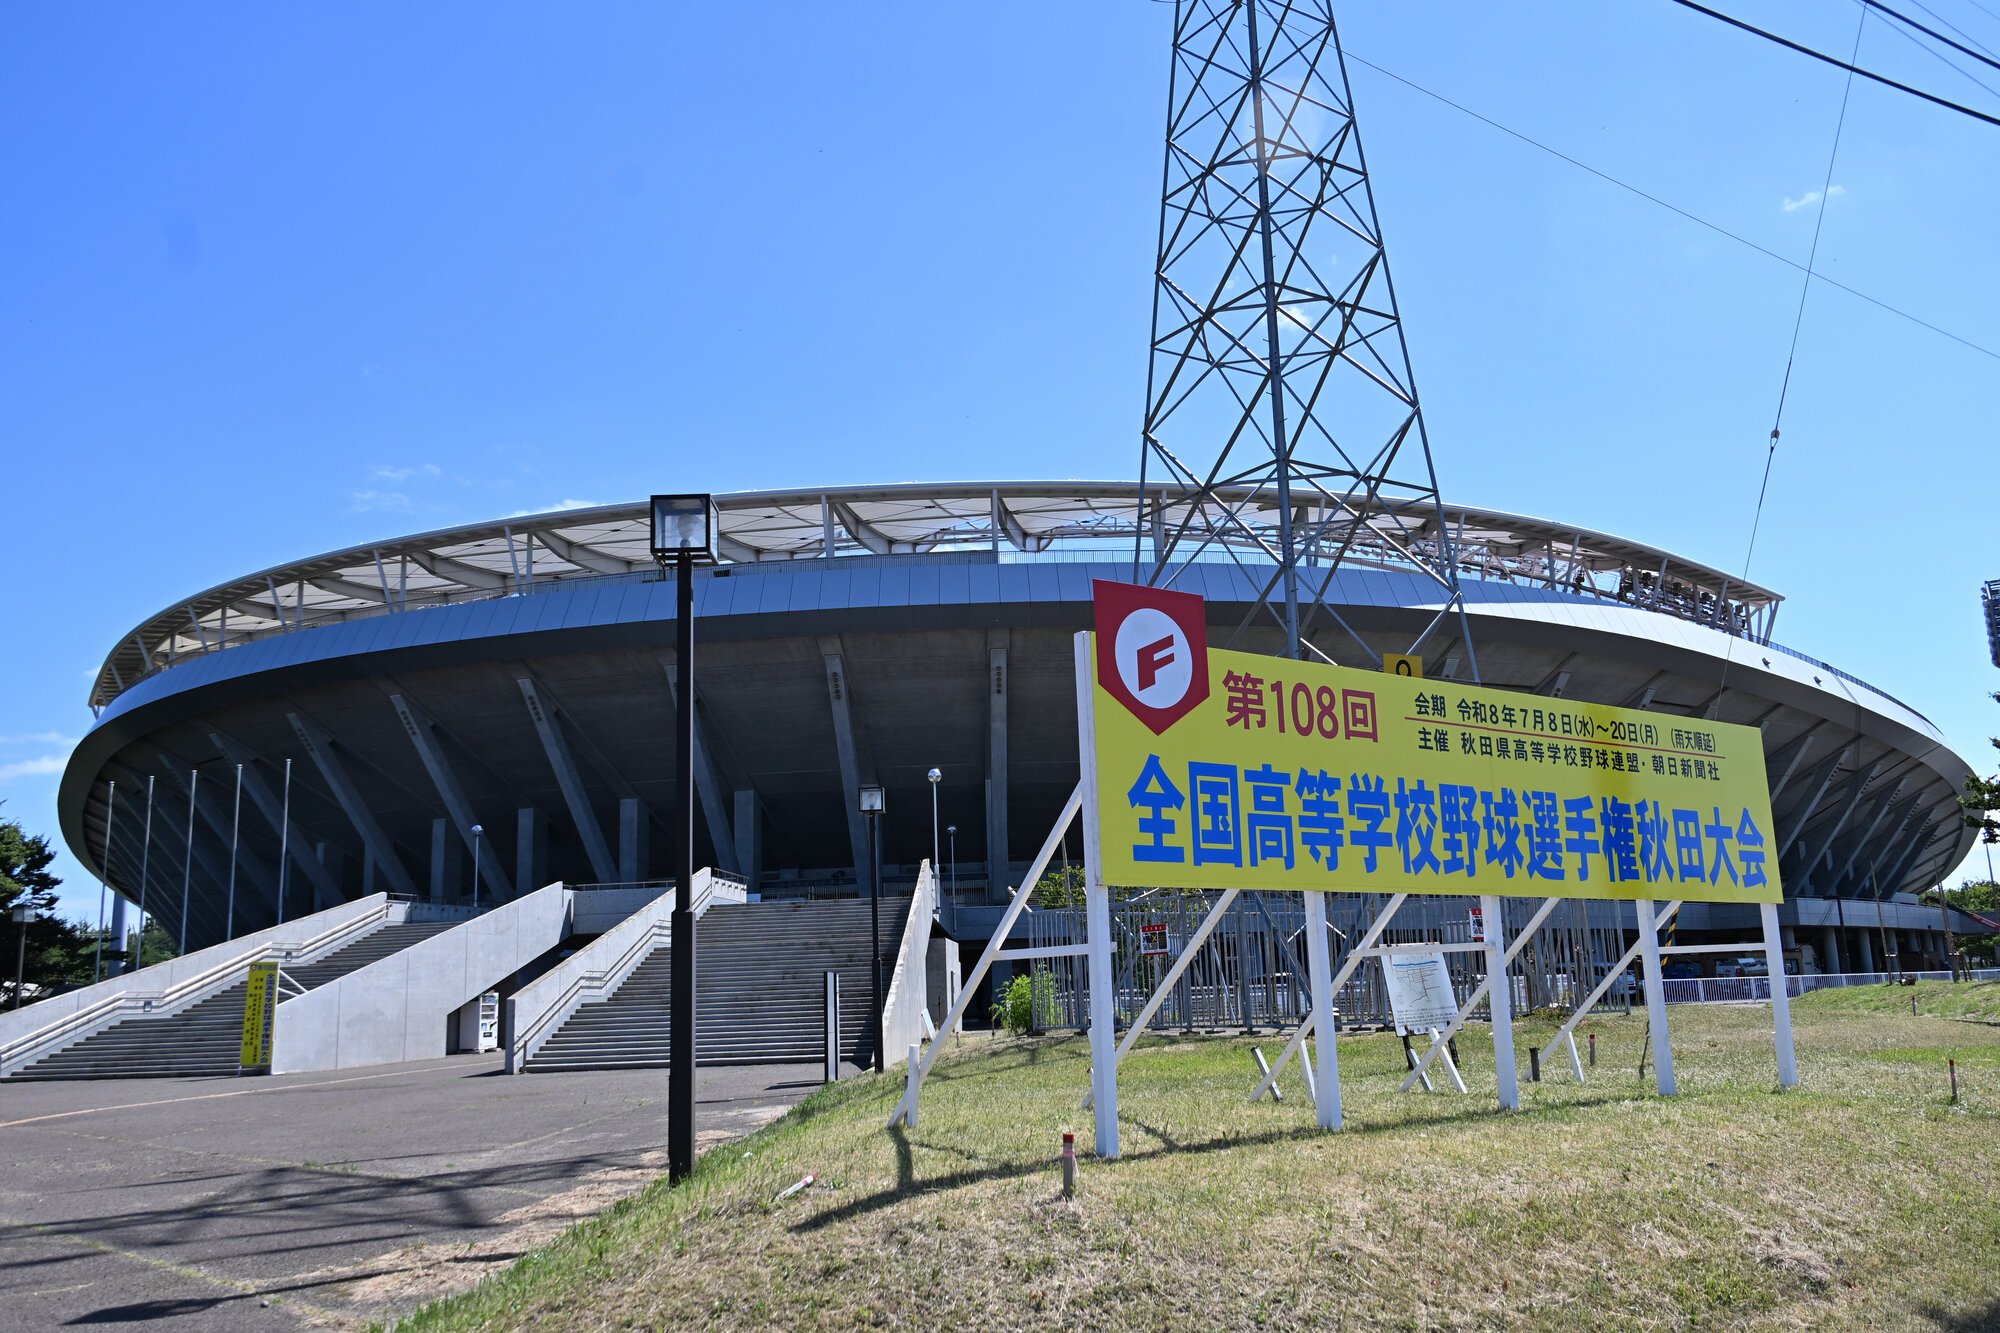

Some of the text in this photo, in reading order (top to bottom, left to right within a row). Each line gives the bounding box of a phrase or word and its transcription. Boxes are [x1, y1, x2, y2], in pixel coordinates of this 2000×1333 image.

[1137, 634, 1175, 692] F
[1222, 669, 1379, 743] 第108回
[1415, 692, 1447, 718] 会期
[1670, 728, 1716, 753] (雨天順延)
[1418, 727, 1450, 752] 主催
[1127, 753, 1767, 889] 全国高等学校野球選手権秋田大会
